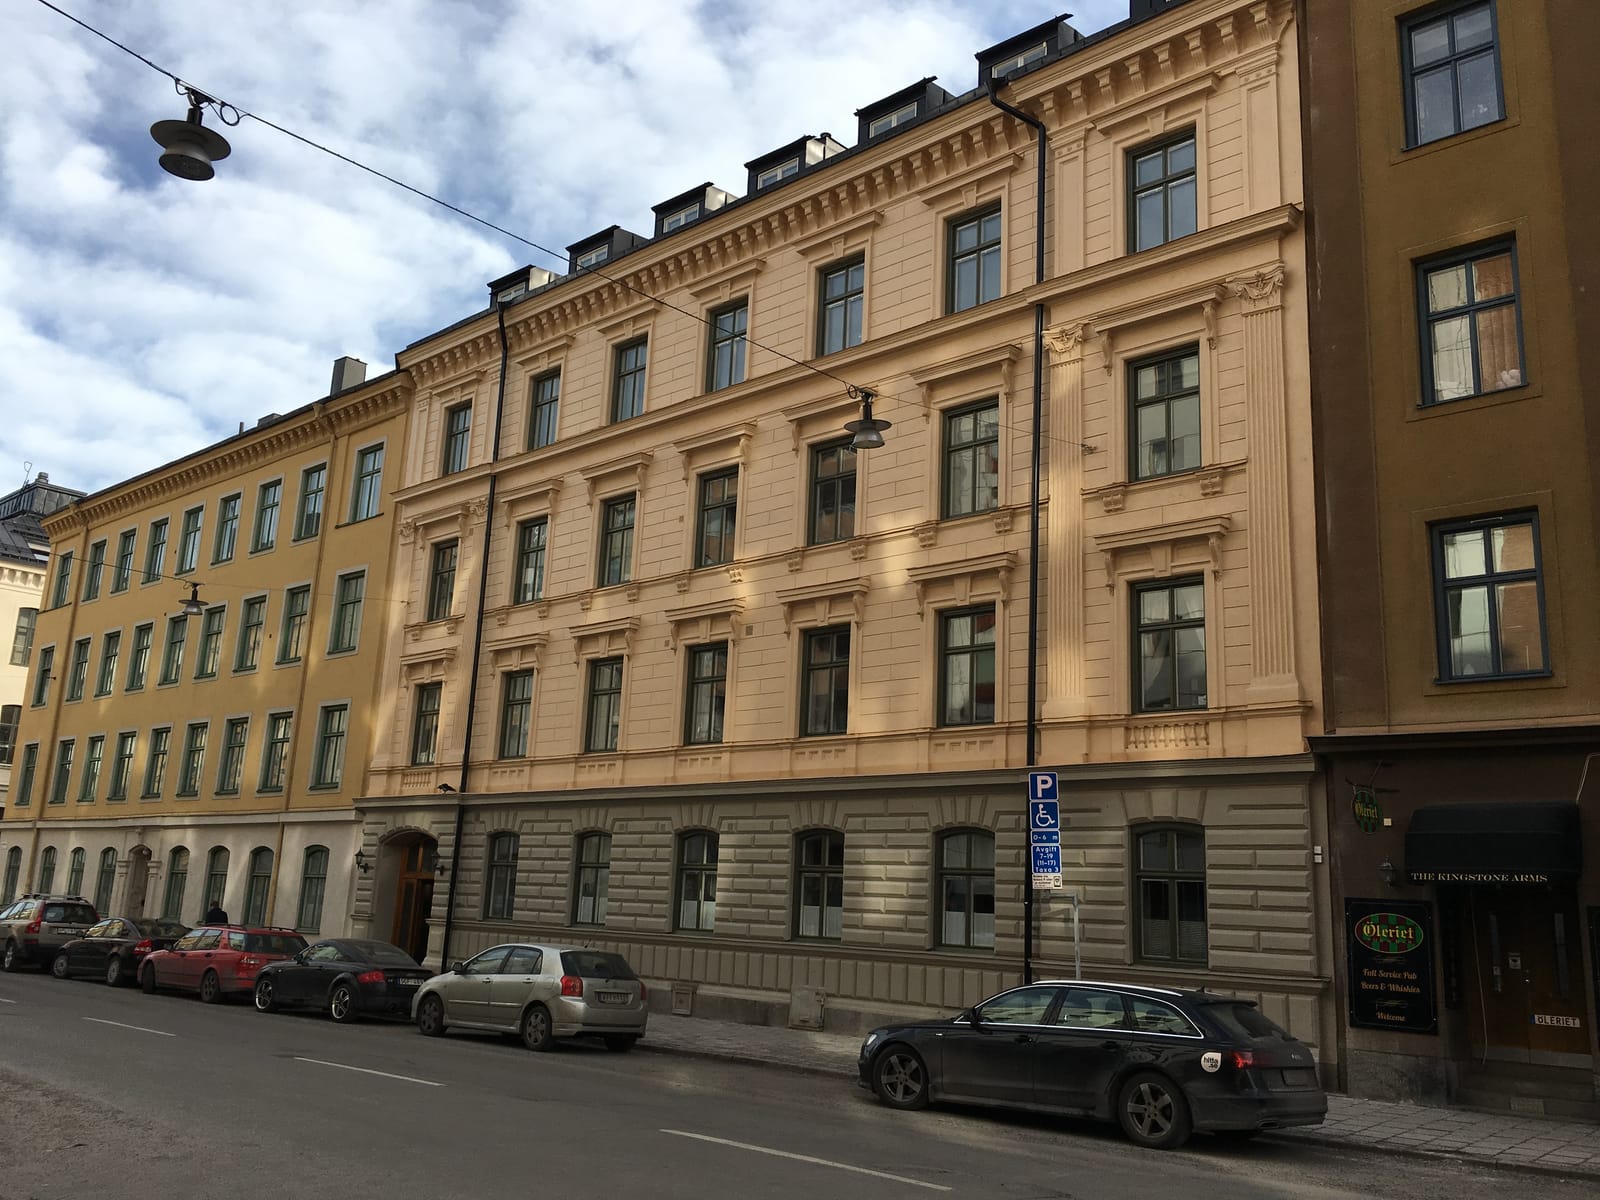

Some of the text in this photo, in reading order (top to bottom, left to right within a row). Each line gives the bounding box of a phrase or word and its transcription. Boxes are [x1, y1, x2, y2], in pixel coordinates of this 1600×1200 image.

[1036, 775, 1053, 798] P
[1410, 872, 1548, 883] THE KINGSTONE ARMS
[1363, 921, 1414, 939] Öleriet
[1362, 968, 1417, 980] Full Service Pub
[1537, 1015, 1577, 1026] ÖLERIET
